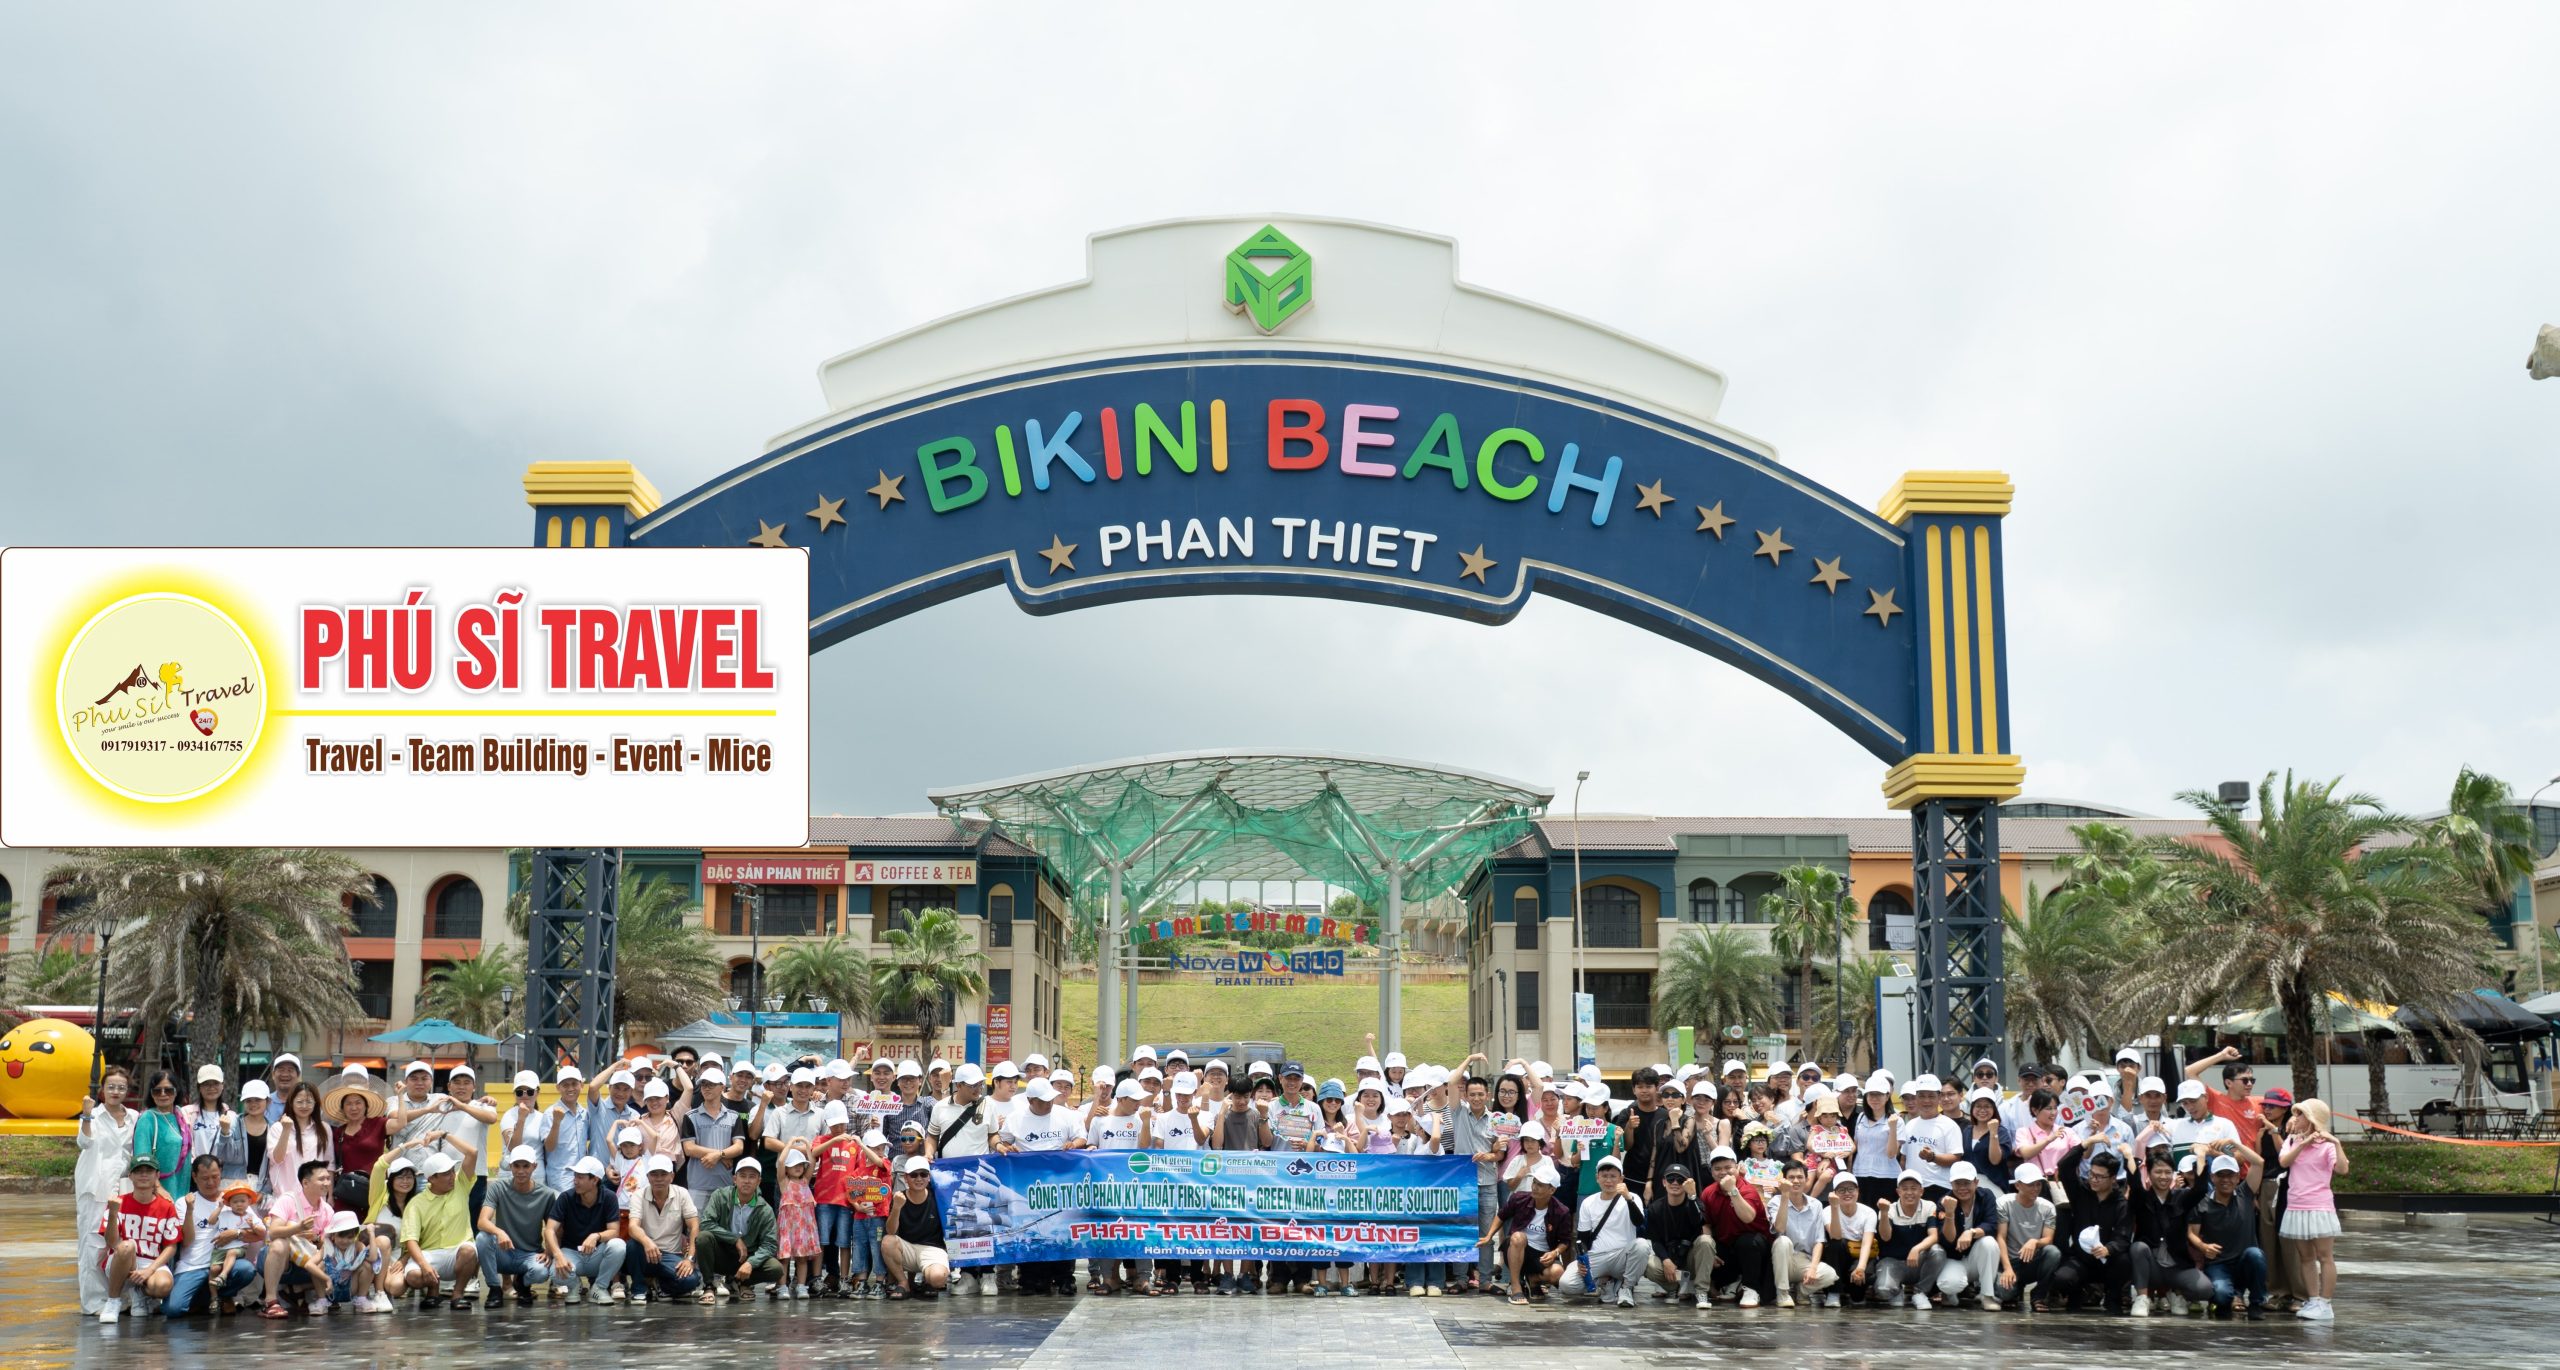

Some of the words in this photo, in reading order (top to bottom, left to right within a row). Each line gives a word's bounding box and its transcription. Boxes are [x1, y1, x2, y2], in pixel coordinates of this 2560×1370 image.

[917, 399, 1230, 514] BIKINI
[1267, 399, 1623, 526] BEACH
[1099, 517, 1254, 567] PHAN
[1271, 517, 1438, 573] THIET
[707, 864, 733, 882] ĐẶC
[737, 862, 763, 880] SẢN
[766, 866, 802, 880] PHAN
[805, 864, 840, 880] THIẾT
[881, 866, 929, 880] COFFEE
[933, 866, 943, 880] &
[948, 866, 972, 880] TEA
[1129, 915, 1202, 945] MIAMI
[1210, 912, 1281, 934] NIGHT
[1285, 914, 1382, 946] MARKET
[1215, 977, 1252, 986] PHAN
[1257, 977, 1295, 986] THIET
[93, 1027, 132, 1035] YUNDAI
[880, 1044, 920, 1059] COFFE
[947, 1045, 963, 1059] TE
[880, 1101, 902, 1110] TRAVEL
[1040, 1131, 1062, 1139] GCSE
[1116, 1130, 1137, 1138] GCSE
[1584, 1125, 1606, 1135] TRAVEL
[1919, 1136, 1937, 1146] GCSE
[1227, 1158, 1252, 1166] GREEN
[1254, 1159, 1277, 1167] MARK
[1315, 1160, 1357, 1173] GCSE
[1028, 1180, 1058, 1209] CÔNG
[1060, 1184, 1073, 1208] TY
[1076, 1172, 1091, 1207] CỔ
[1093, 1174, 1121, 1208] PHẦN
[1124, 1177, 1139, 1208] KỸ
[1142, 1179, 1175, 1214] THUẬT
[1177, 1185, 1208, 1209] FIRST
[1210, 1186, 1246, 1210] GREEN
[1256, 1186, 1292, 1211] GREEN
[1295, 1187, 1327, 1211] MARK
[1337, 1188, 1373, 1212] GREEN
[1375, 1188, 1403, 1212] CARE
[1406, 1188, 1458, 1213] SOLUTION
[1070, 1217, 1149, 1239] PHÁT
[1157, 1217, 1253, 1240] TRIỂN
[1260, 1219, 1326, 1242] BỀN
[1333, 1222, 1418, 1243] VỮNG
[1528, 1223, 1545, 1233] GCS
[1144, 1246, 1173, 1255] Hàm
[1176, 1246, 1212, 1256] Thuận
[1215, 1247, 1247, 1255] Nam:
[1251, 1248, 1341, 1257] 01-03/08/2025
